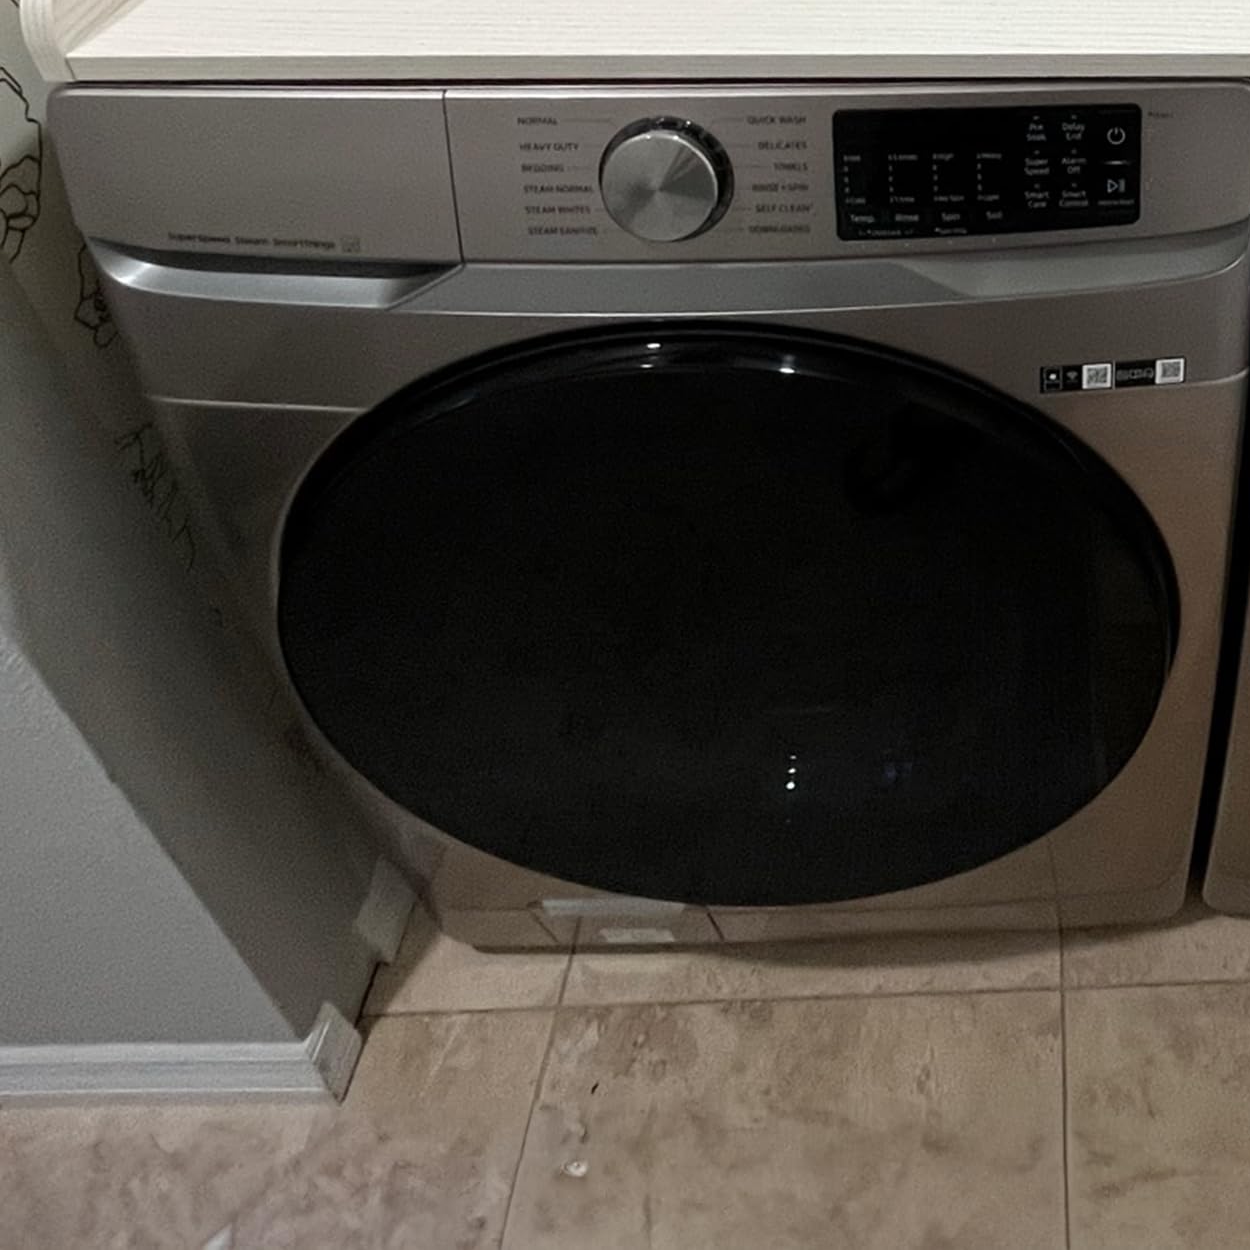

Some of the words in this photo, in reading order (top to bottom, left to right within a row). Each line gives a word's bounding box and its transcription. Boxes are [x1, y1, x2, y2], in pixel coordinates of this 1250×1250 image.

[517, 116, 558, 126] NORMAL
[778, 116, 807, 125] WASH
[1061, 122, 1086, 133] Delay
[519, 142, 552, 152] HEAVY
[553, 142, 579, 152] DUTY
[758, 141, 808, 150] DELICATES
[1066, 165, 1081, 174] Off
[524, 184, 554, 194] STEAM
[556, 184, 594, 194] NORMAL
[525, 205, 556, 215] STEAM
[755, 204, 776, 214] SELF
[528, 226, 558, 236] STEAM
